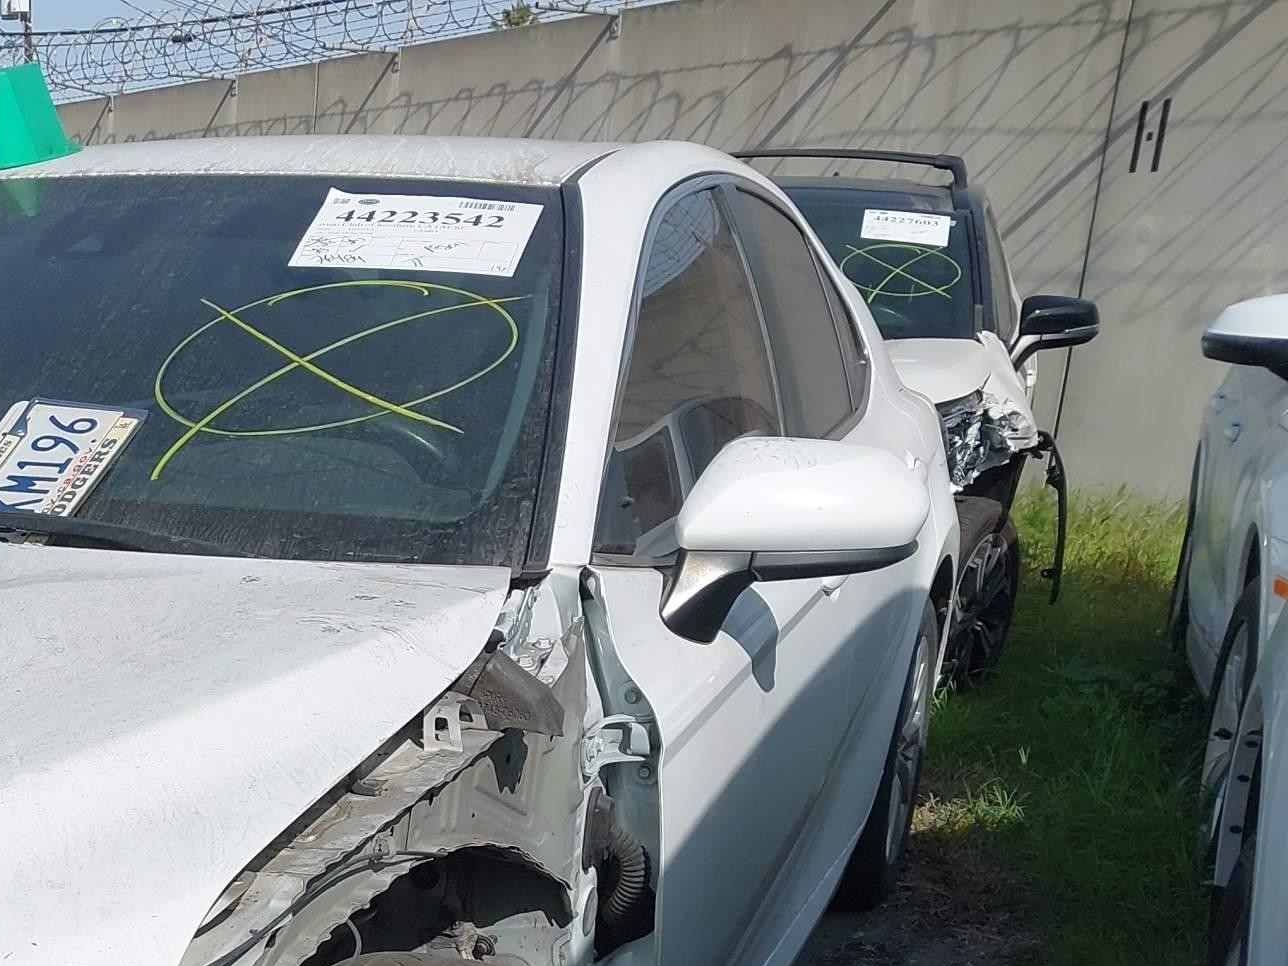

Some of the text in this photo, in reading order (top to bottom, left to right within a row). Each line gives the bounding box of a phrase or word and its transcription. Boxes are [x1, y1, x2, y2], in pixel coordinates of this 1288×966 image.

[336, 209, 505, 228] 44223542
[873, 215, 940, 227] 44227603
[52, 436, 117, 515] ODGERS
